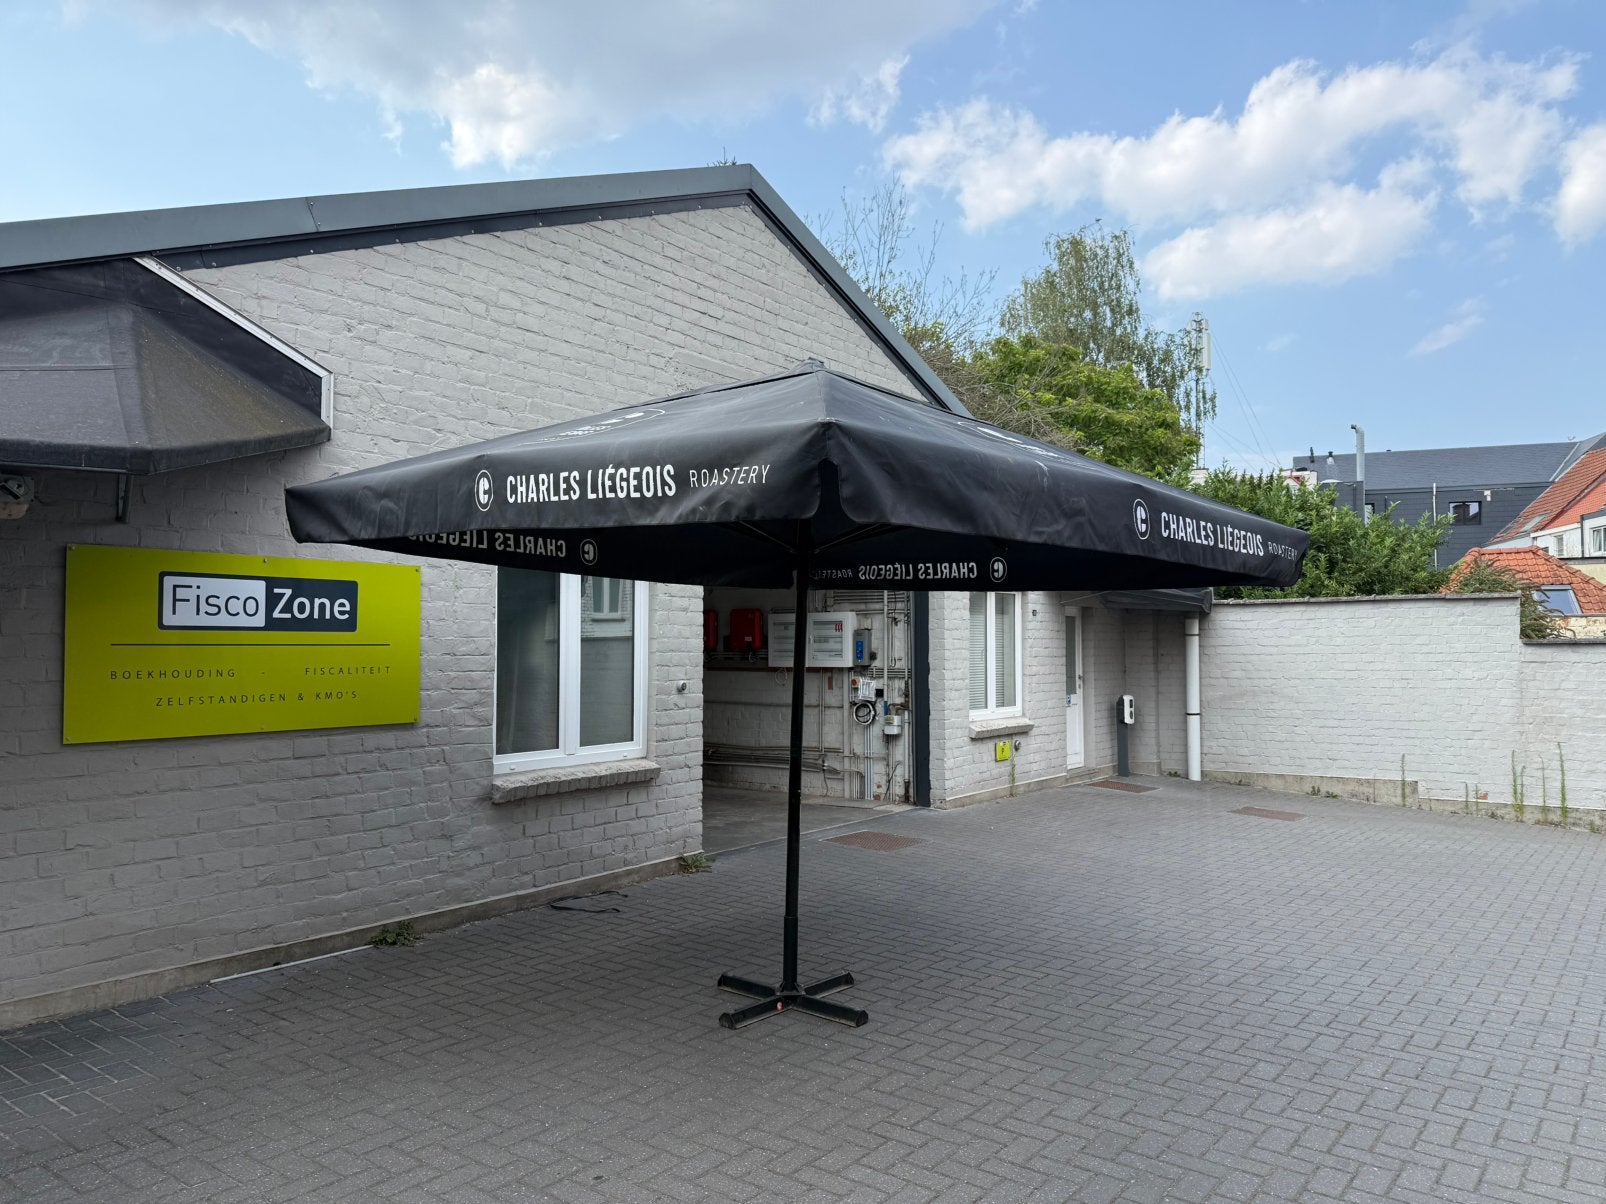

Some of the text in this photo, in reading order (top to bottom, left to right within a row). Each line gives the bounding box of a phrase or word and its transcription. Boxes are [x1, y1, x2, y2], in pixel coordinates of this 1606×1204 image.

[506, 471, 580, 504] CHARLES
[587, 464, 676, 499] LIÉGEOIS
[690, 465, 770, 488] ROASTERY
[1161, 511, 1214, 546] CHARLES
[1217, 525, 1264, 557] LIÉGEOIS
[110, 668, 236, 680] BOEKHOUDING
[305, 666, 392, 675] FISCALITEIT
[155, 693, 287, 707] ZELFSTANDIGEN
[297, 692, 305, 701] &
